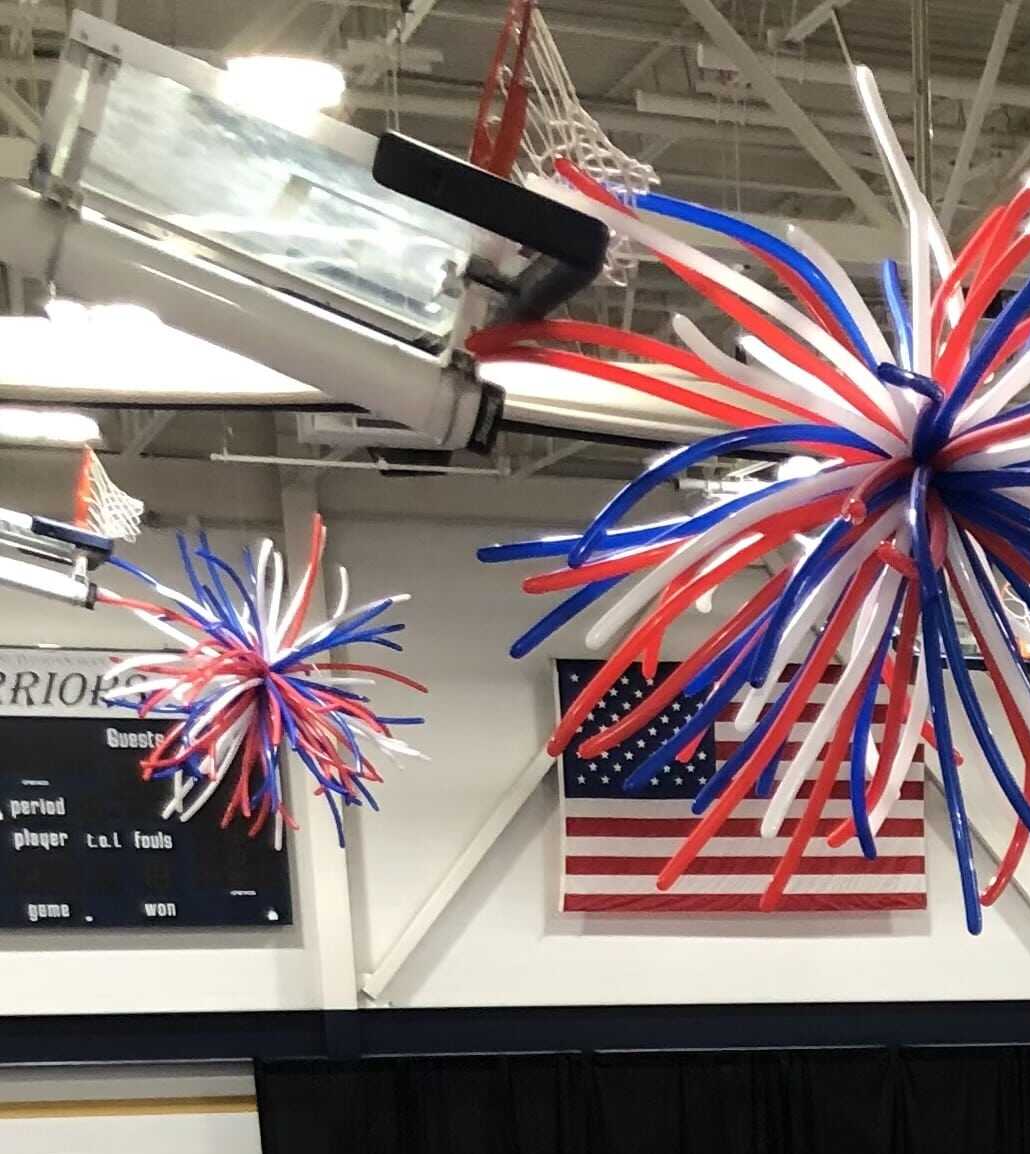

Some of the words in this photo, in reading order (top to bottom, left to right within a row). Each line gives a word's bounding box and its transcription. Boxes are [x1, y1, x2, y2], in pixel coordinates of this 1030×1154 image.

[106, 727, 166, 748] Guests
[9, 797, 66, 819] period
[13, 828, 69, 851] player
[134, 830, 173, 849] fouls
[28, 903, 70, 922] game
[144, 902, 177, 917] won
